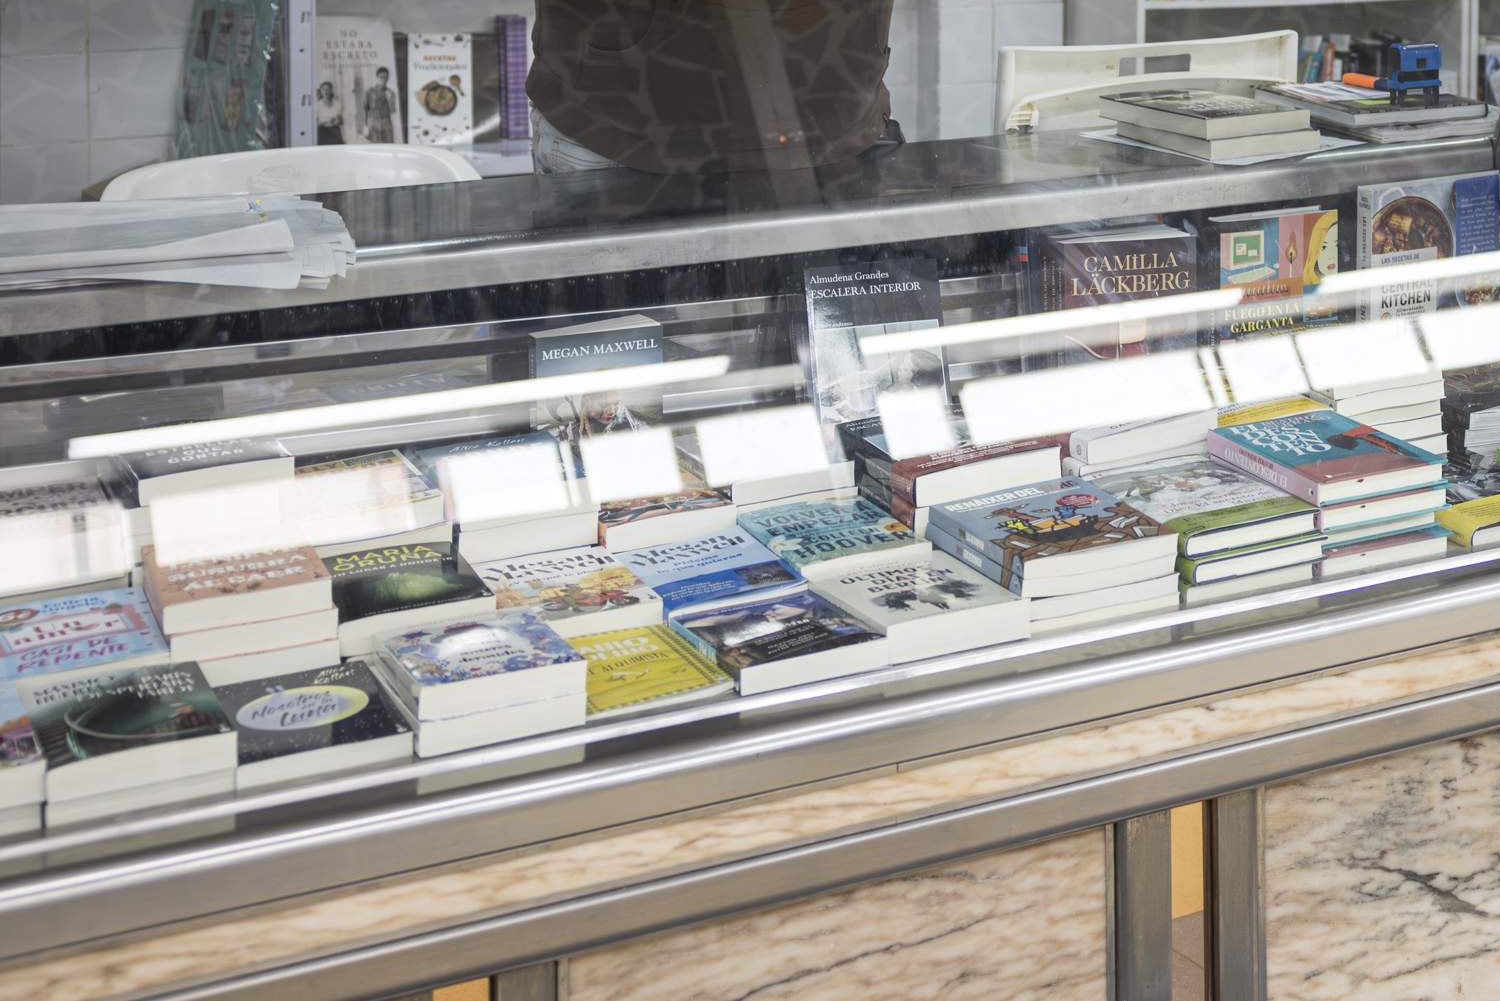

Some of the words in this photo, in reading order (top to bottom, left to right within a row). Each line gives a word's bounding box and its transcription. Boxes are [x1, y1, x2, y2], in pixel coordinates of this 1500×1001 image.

[1084, 251, 1178, 273] CAMILLA
[1381, 256, 1391, 265] LAS
[810, 274, 853, 285] Almudena
[855, 270, 889, 280] Grandes
[1071, 271, 1191, 298] LÄCKBERG
[811, 287, 867, 300] ESCALERA
[870, 281, 922, 295] INTERIOR
[1381, 291, 1431, 309] KITCHEN
[1224, 306, 1265, 321] FUEGO
[1268, 304, 1283, 316] EN
[1230, 316, 1294, 333] GARGANTA
[542, 345, 590, 361] MEGAN
[593, 338, 659, 356] MAXWELL
[167, 448, 244, 464] CONTAR
[184, 446, 222, 456] QUE
[757, 502, 847, 529] VOLVER
[853, 500, 873, 513] A
[767, 510, 887, 537] EMPEZAR
[806, 527, 882, 543] COLLEEN
[793, 531, 912, 559] HOOVER
[602, 651, 669, 673] ALQUIMISTA
